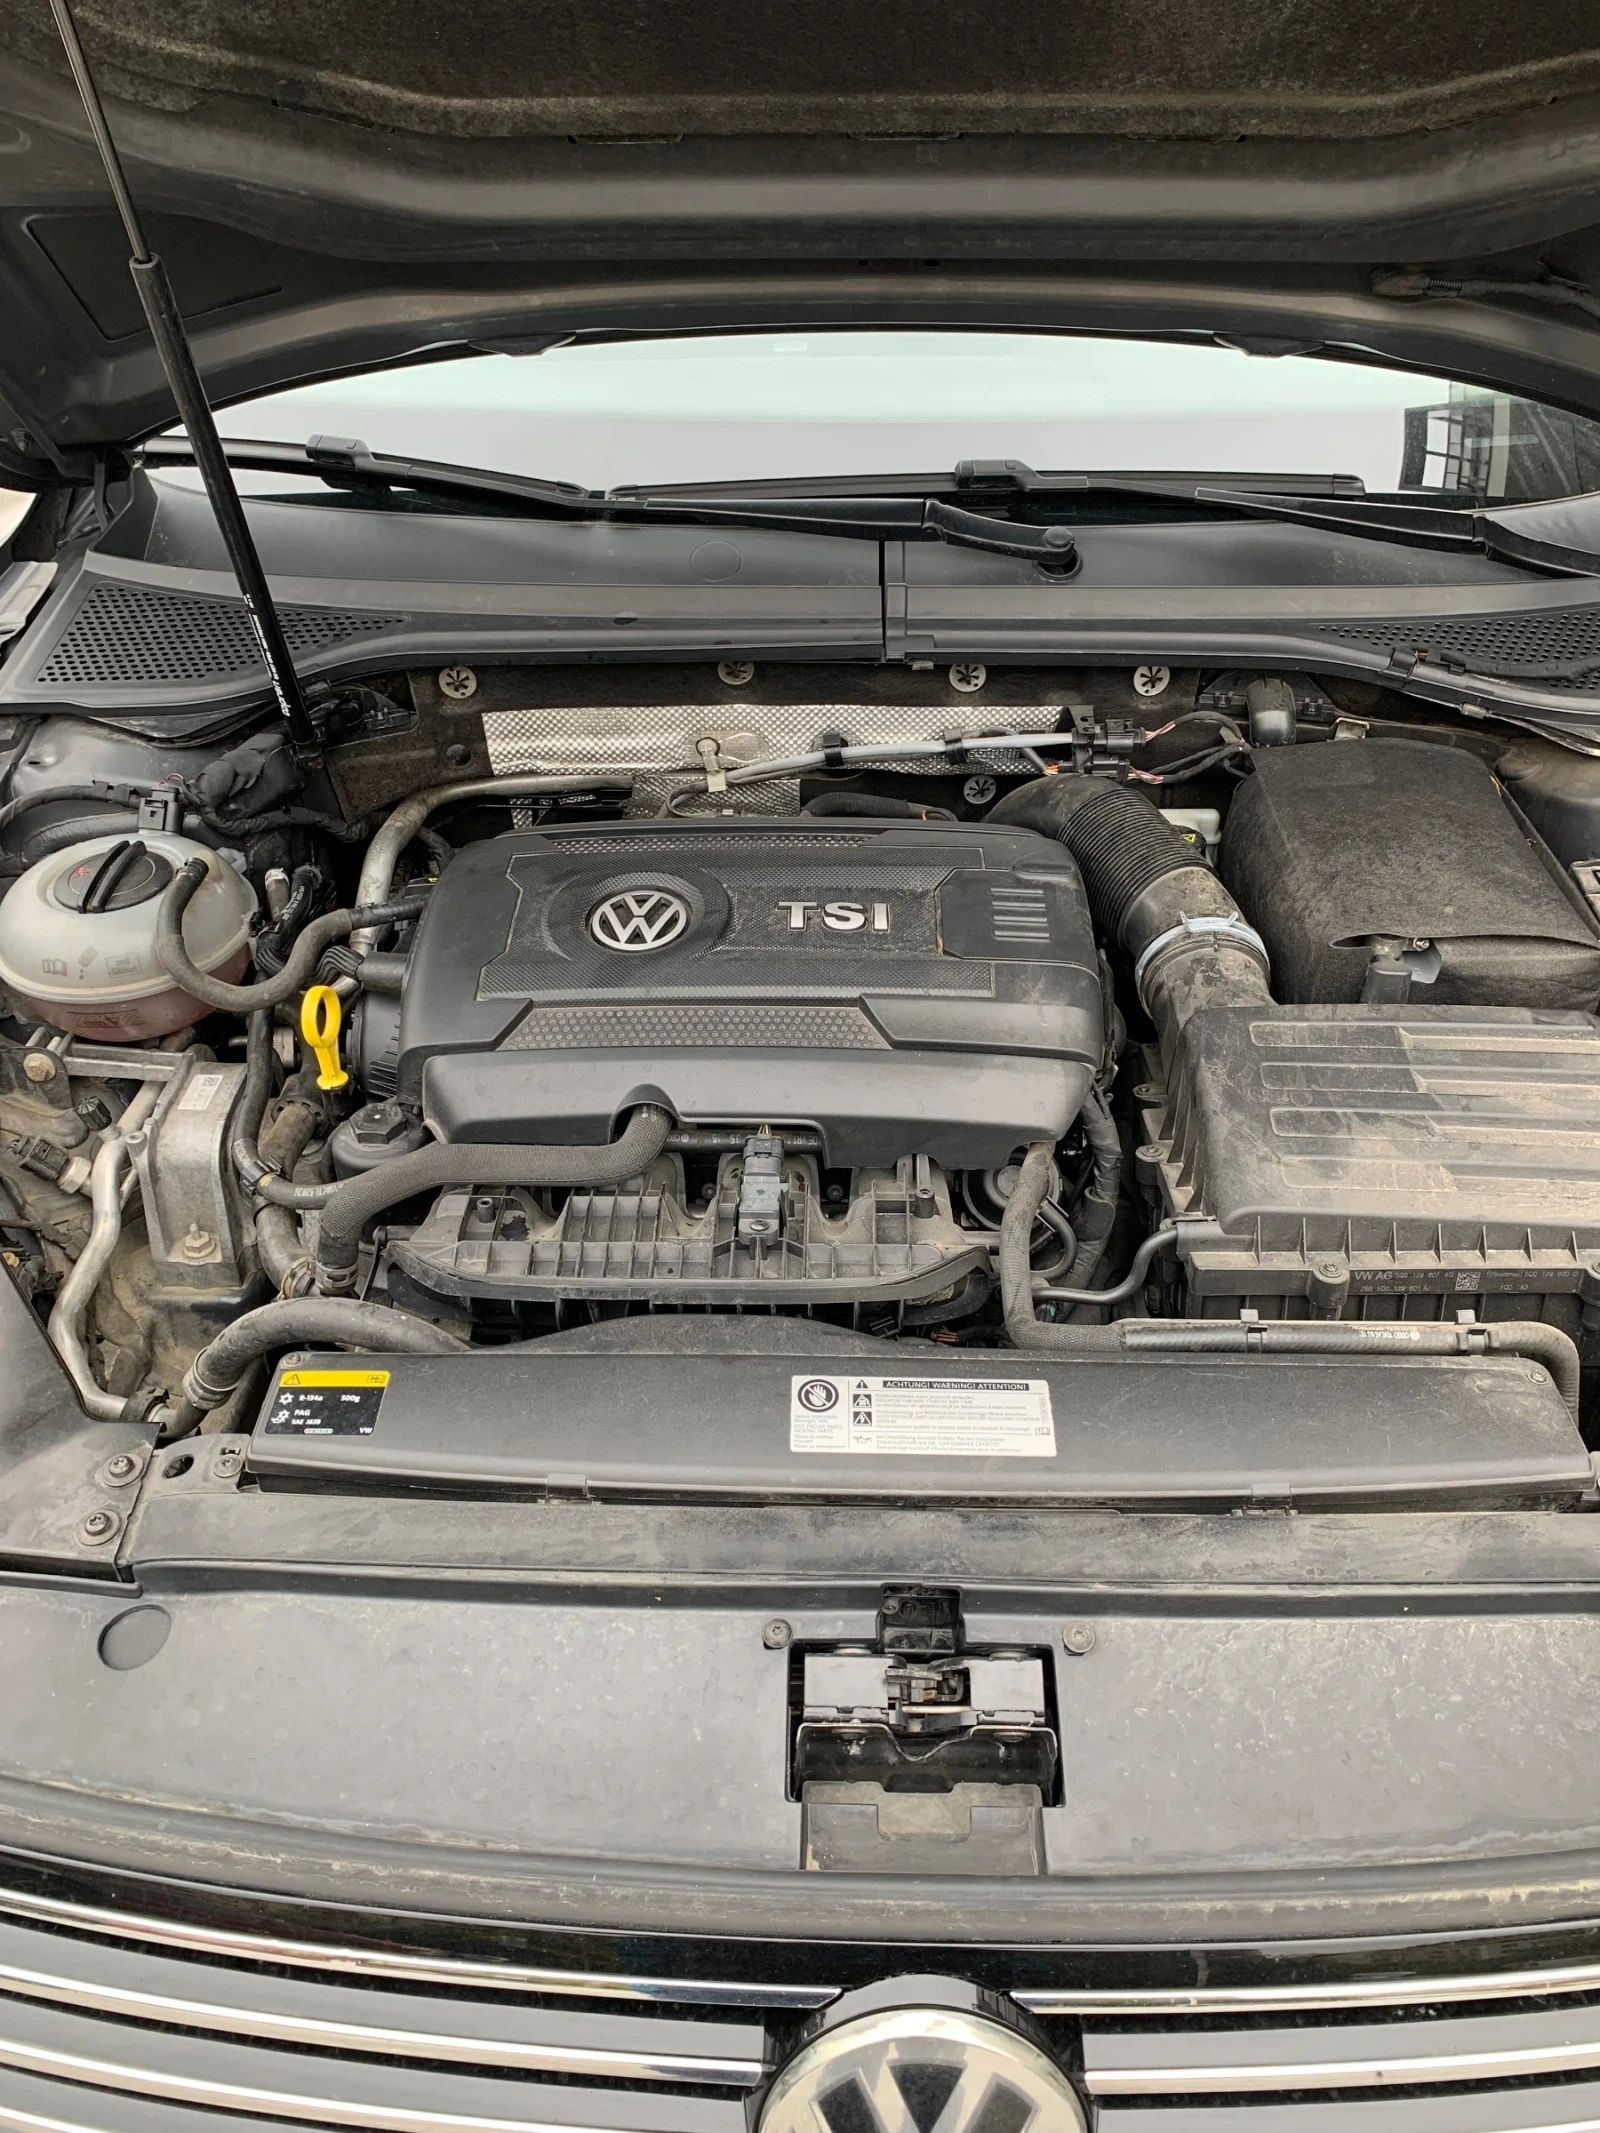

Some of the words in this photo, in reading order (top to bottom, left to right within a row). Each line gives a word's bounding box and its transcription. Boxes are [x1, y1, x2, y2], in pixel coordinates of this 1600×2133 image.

[591, 889, 687, 951] VW
[777, 901, 890, 932] TSI
[84, 1020, 108, 1028] min
[1354, 1272, 1374, 1280] VW
[1375, 1272, 1393, 1280] AG
[886, 1380, 930, 1388] ACHTUNG!
[931, 1382, 976, 1390] WARNING!
[977, 1382, 1026, 1390] ATTENTION!
[340, 1394, 360, 1402] 500g
